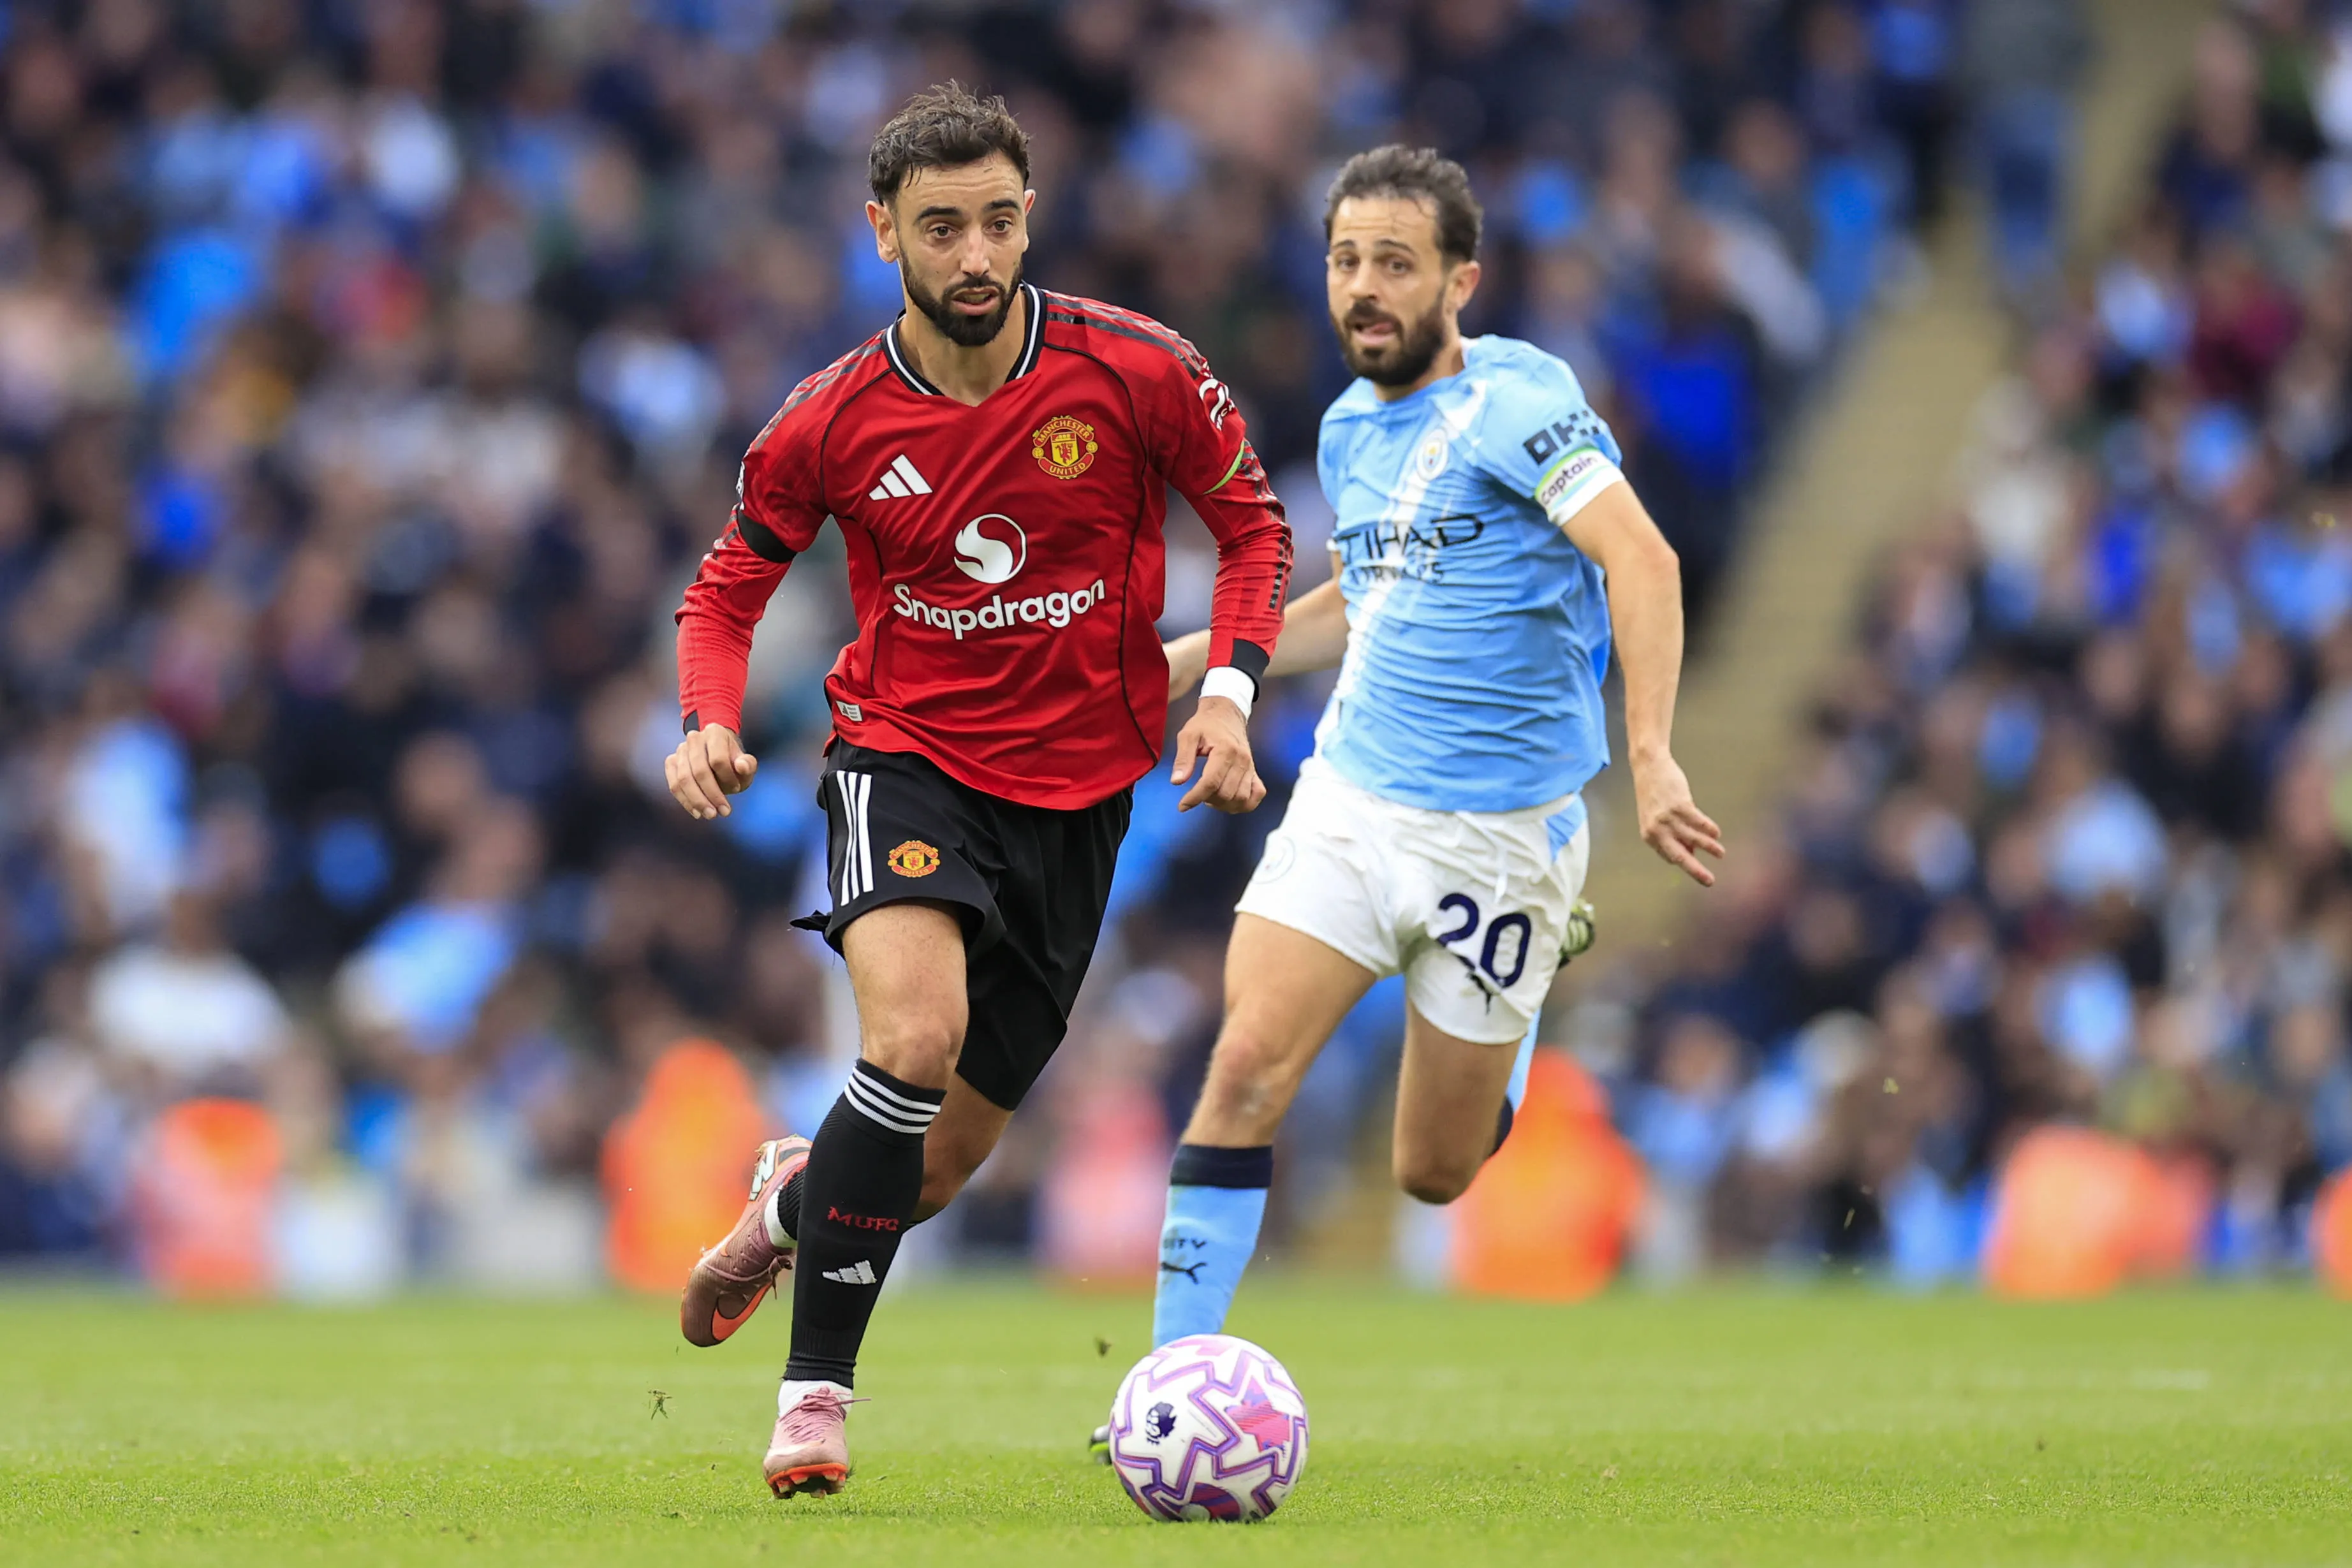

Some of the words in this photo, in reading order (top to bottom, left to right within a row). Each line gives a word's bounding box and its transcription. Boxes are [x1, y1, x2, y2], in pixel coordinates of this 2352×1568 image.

[1038, 420, 1090, 443] MANCHESTER
[1049, 462, 1085, 475] UNITED
[1334, 514, 1484, 565] TIHAD
[893, 579, 1105, 640] Snapdragon
[1437, 893, 1531, 989] 20
[828, 1206, 899, 1231] MUFC
